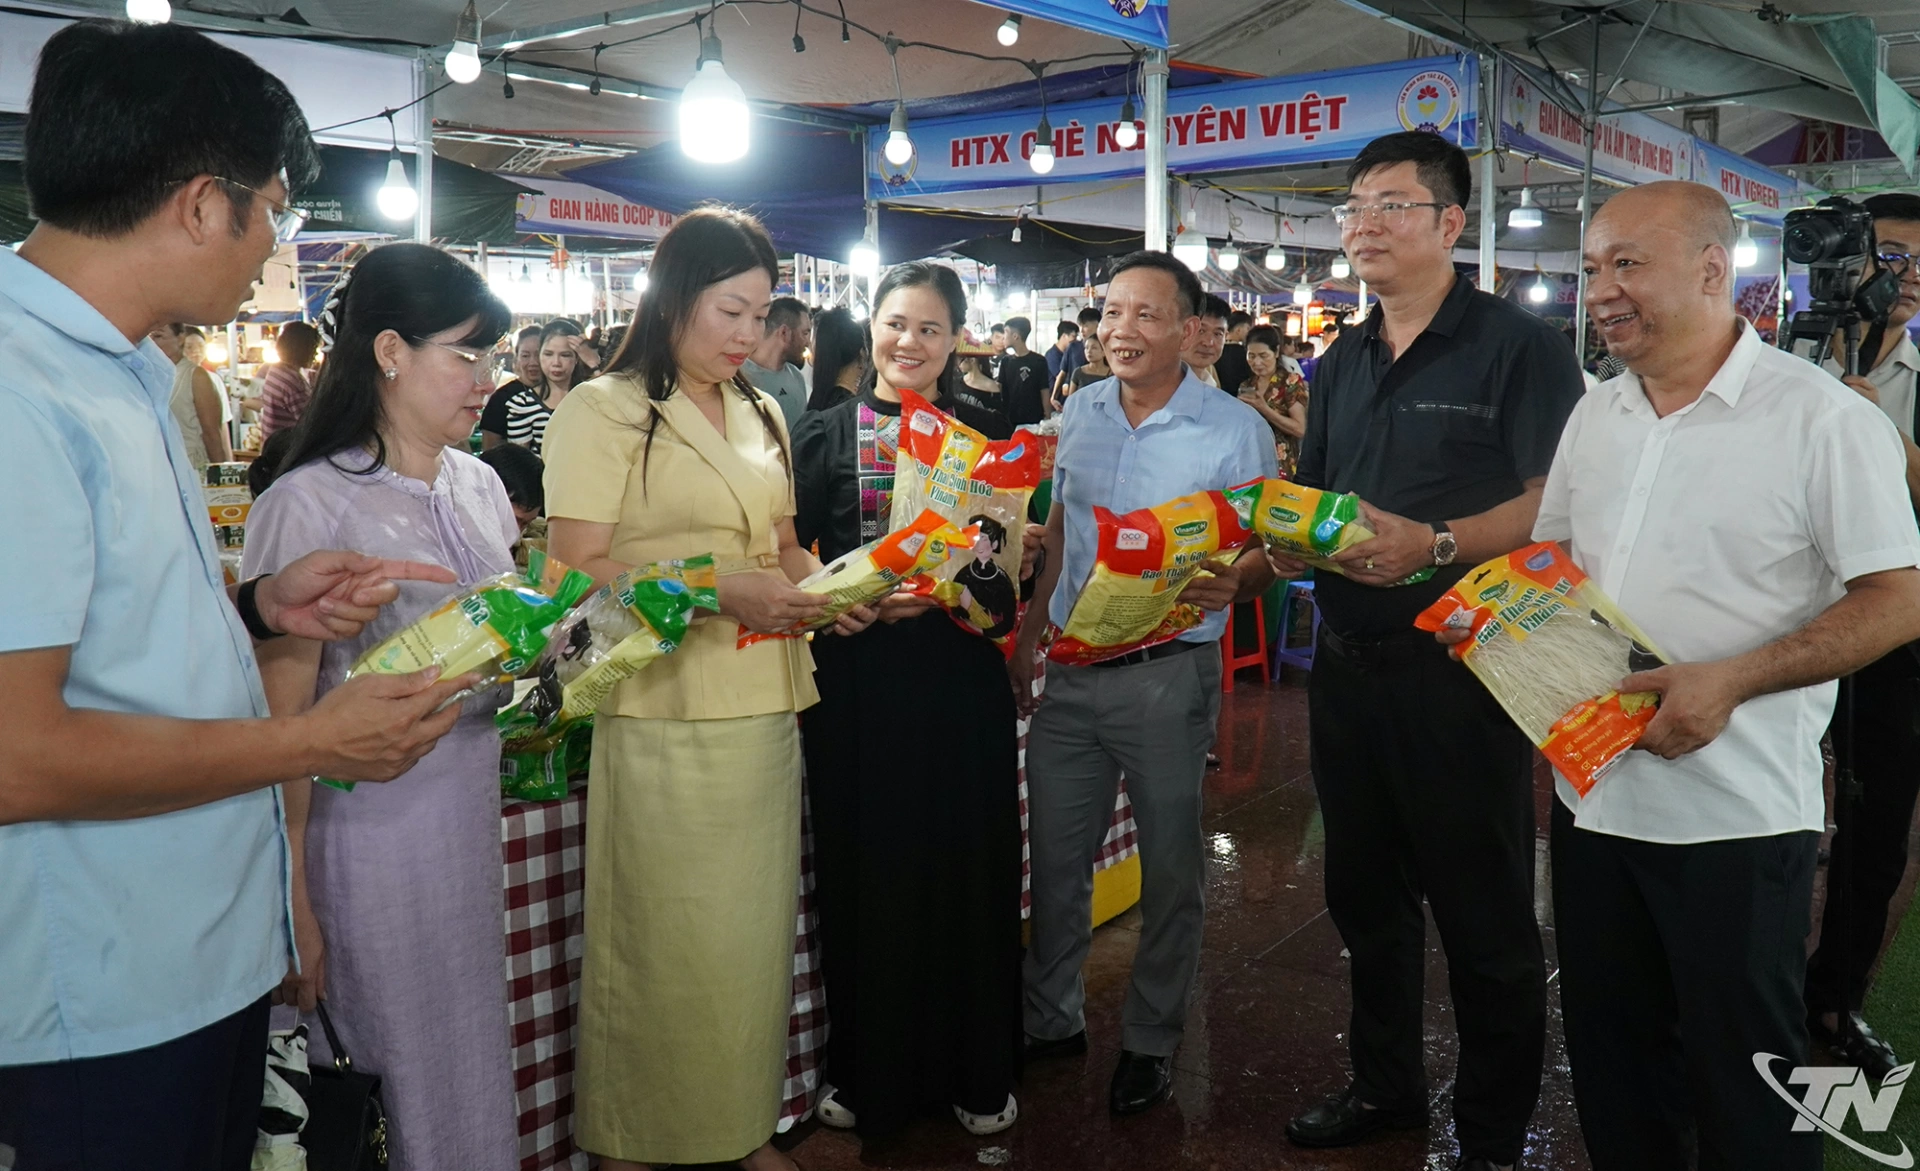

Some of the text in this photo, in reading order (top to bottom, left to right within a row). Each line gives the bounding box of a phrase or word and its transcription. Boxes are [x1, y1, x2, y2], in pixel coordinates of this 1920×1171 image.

[951, 135, 1010, 168] HTX
[1259, 91, 1348, 141] VIỆT
[1539, 100, 1559, 138] GIAN
[1721, 167, 1779, 210] HTX VGREEN
[550, 198, 581, 220] GIAN
[585, 197, 619, 223] HÀNG
[623, 204, 655, 226] OCOP
[969, 478, 993, 497] Hóa
[1141, 569, 1162, 580] Bao
